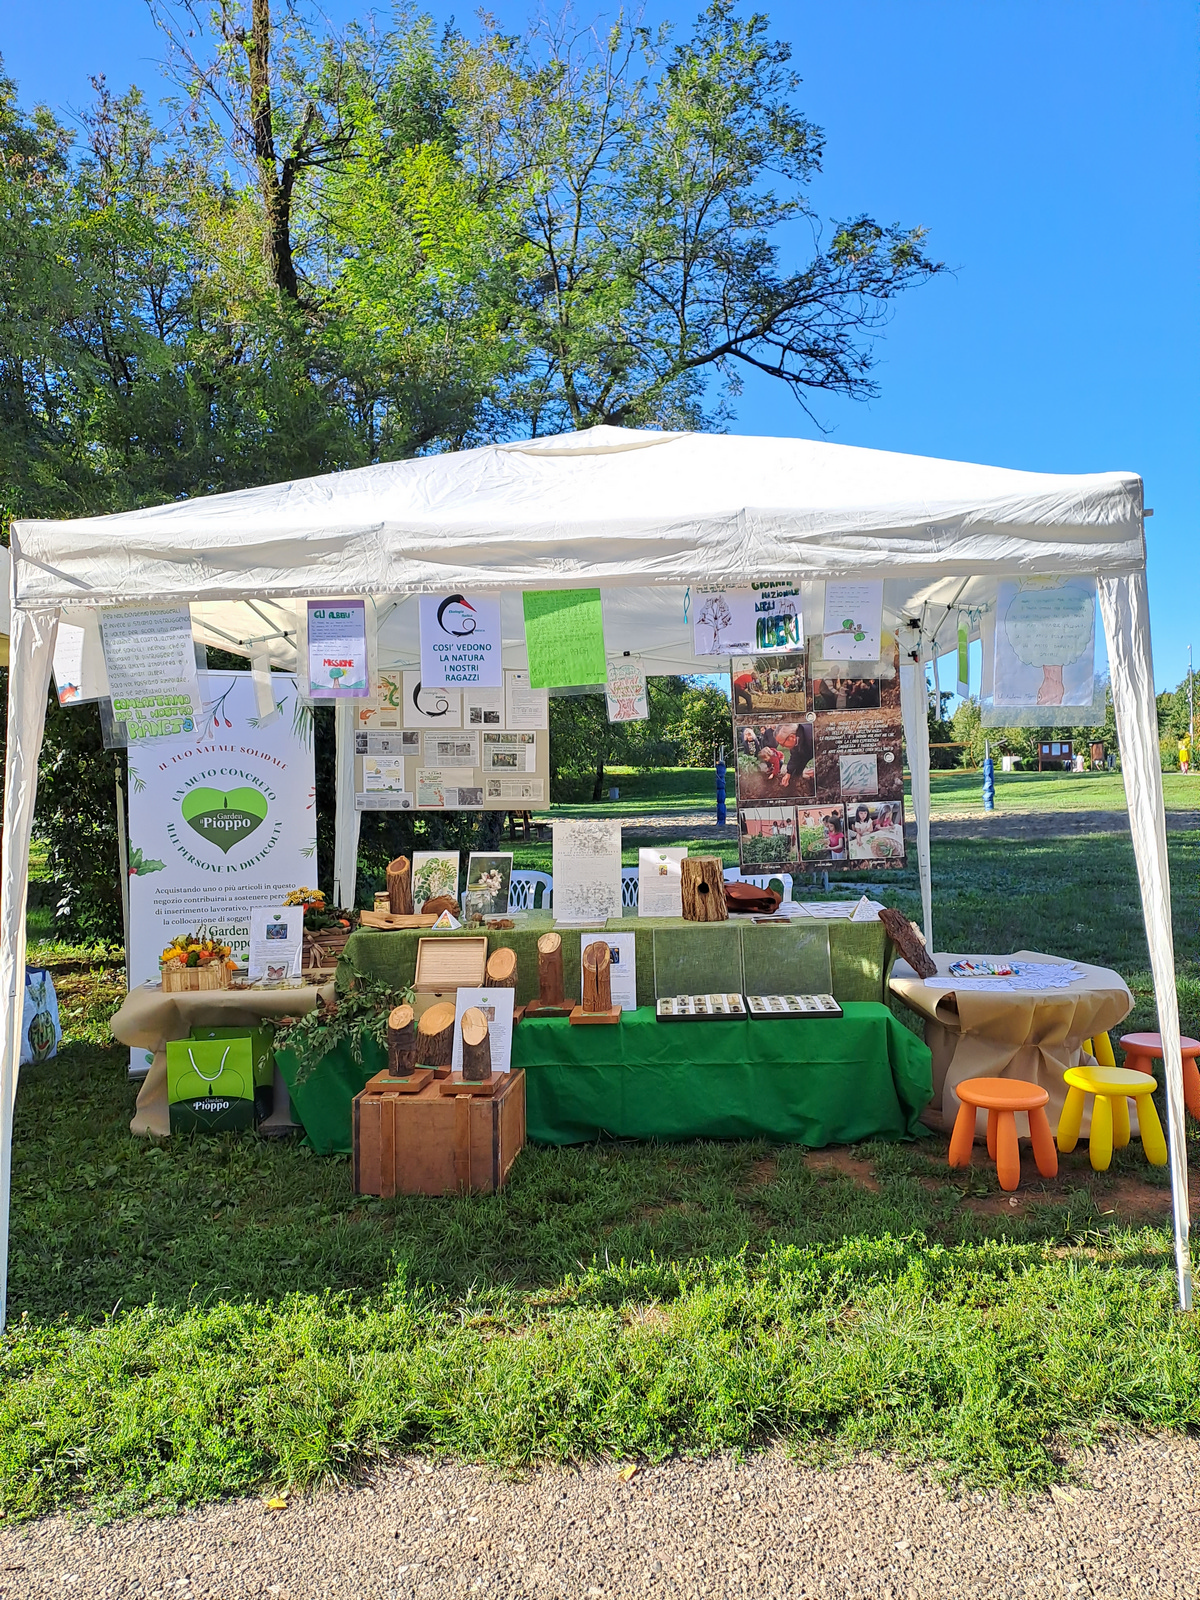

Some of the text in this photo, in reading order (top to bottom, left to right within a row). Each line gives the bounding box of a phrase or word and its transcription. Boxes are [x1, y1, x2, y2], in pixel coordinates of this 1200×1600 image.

[762, 588, 800, 600] NAZIONALE
[754, 600, 775, 612] DEGLI
[756, 614, 800, 649] ALBERI
[432, 644, 492, 652] COSI' VEDONO
[323, 658, 354, 668] MISSIONE
[439, 654, 485, 662] LA NATURA
[444, 664, 479, 672] I NOSTRI
[445, 674, 480, 682] RAGAZZI
[150, 705, 193, 718] NOSTRO
[159, 745, 288, 771] IL TUO NATALE SOLIDALE
[172, 768, 277, 802] UN AIUTO CONCRETO
[217, 812, 243, 820] Garden
[203, 817, 251, 831] Pioppo
[166, 822, 181, 846] ALLE
[177, 845, 224, 873] PERSONE
[226, 865, 238, 873] IN
[155, 887, 201, 895] Acquistando
[224, 884, 236, 893] più
[272, 883, 296, 891] questo
[153, 898, 182, 906] negozio
[184, 895, 227, 903] contribuirai
[164, 906, 209, 914] inserimento
[210, 905, 248, 913] lavorativo,
[171, 917, 217, 925] collocazione
[208, 926, 249, 936] Garden
[195, 1101, 229, 1112] Pioppo
